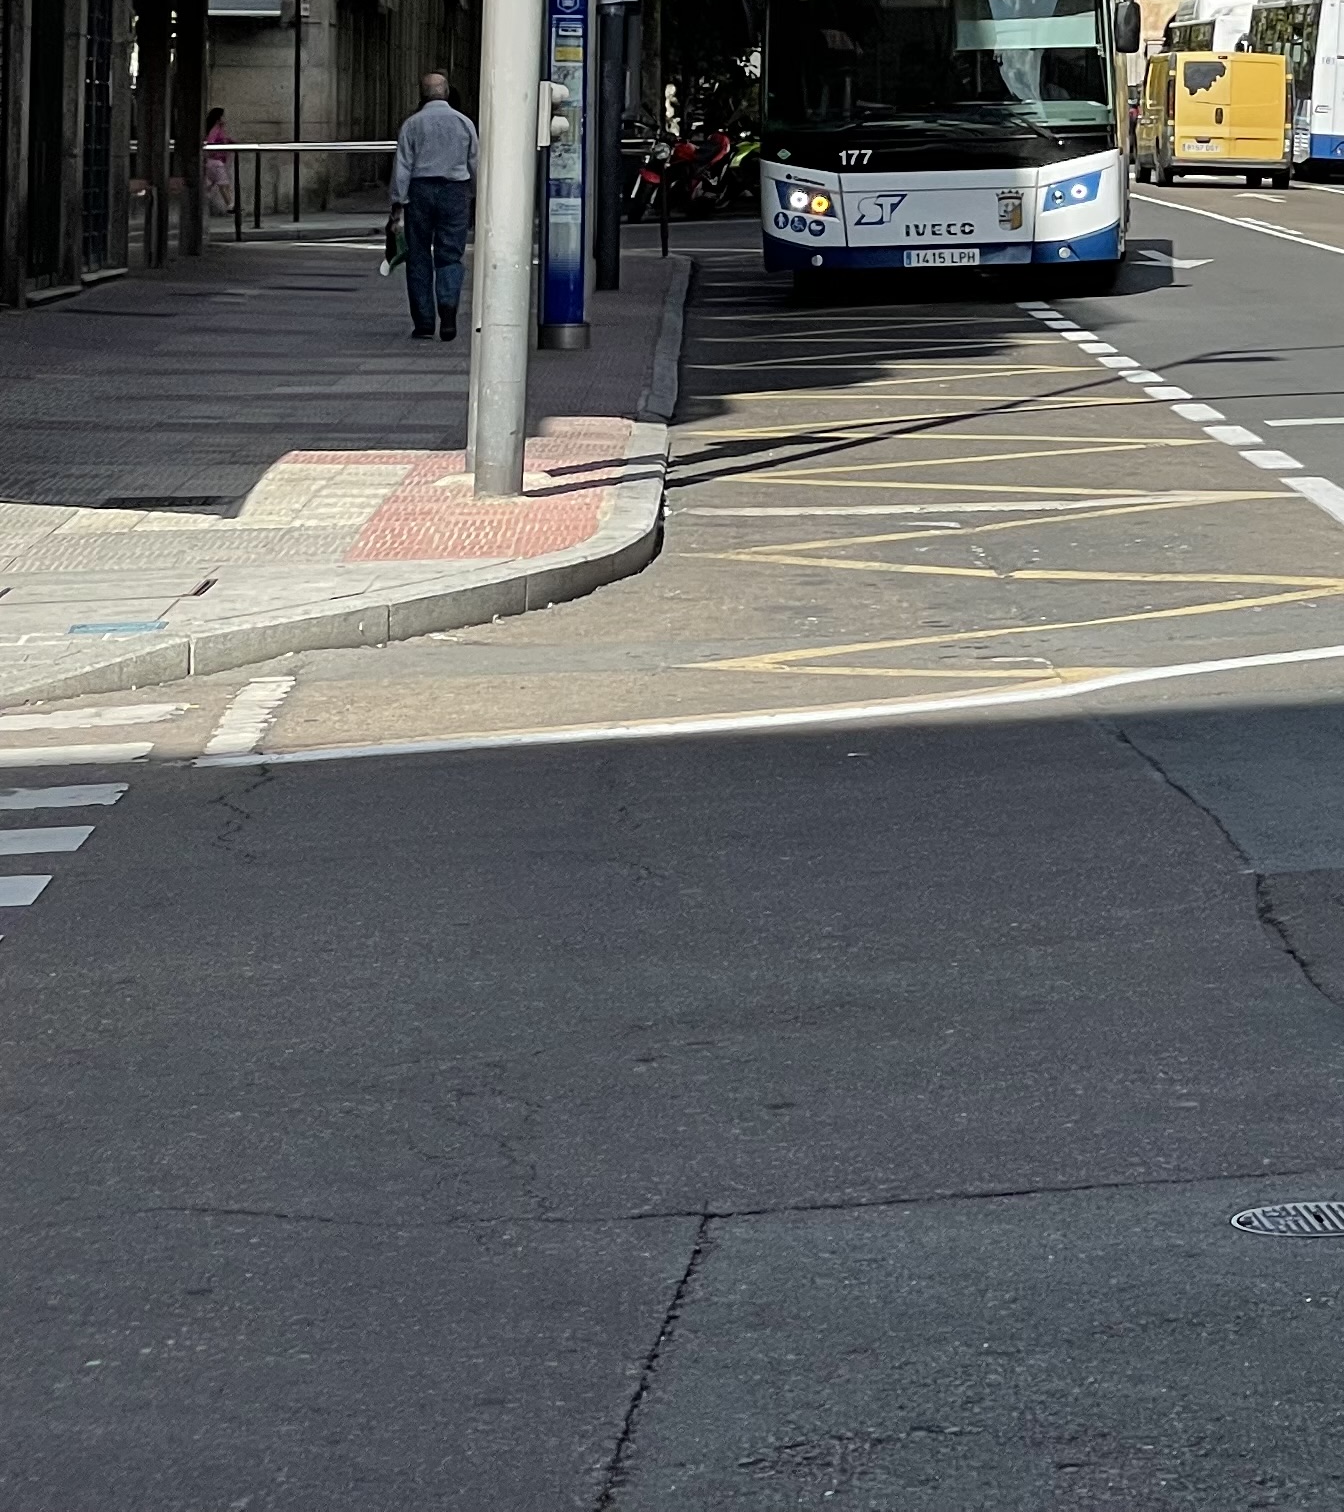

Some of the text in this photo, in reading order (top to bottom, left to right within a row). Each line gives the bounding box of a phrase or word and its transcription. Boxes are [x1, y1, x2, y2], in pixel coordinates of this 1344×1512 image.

[838, 149, 873, 166] 177
[905, 222, 976, 238] IVECO
[915, 250, 976, 265] 1415 LPH
